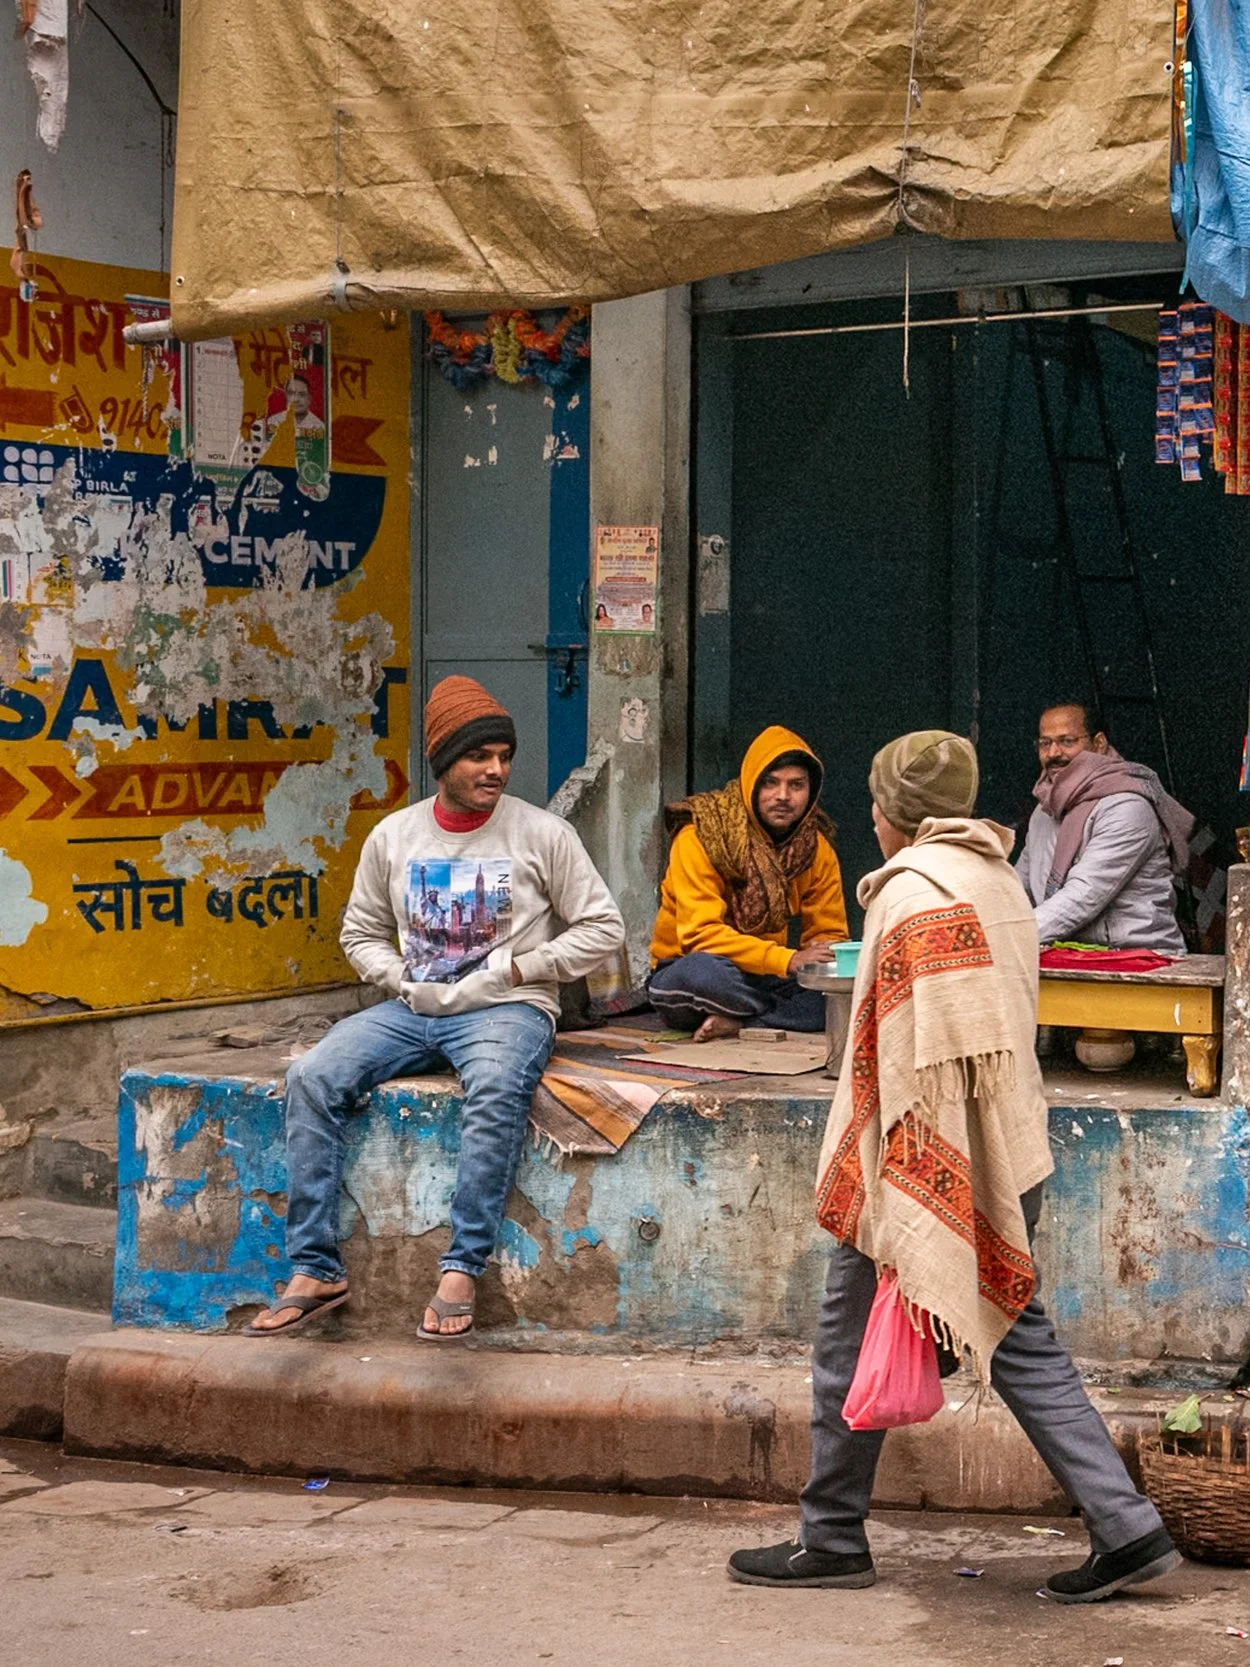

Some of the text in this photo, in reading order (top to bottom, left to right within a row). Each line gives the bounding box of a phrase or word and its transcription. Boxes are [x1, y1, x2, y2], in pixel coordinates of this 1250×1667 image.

[86, 480, 129, 493] BIRLA
[204, 535, 356, 570] CEMNT
[73, 859, 186, 934] सोच
